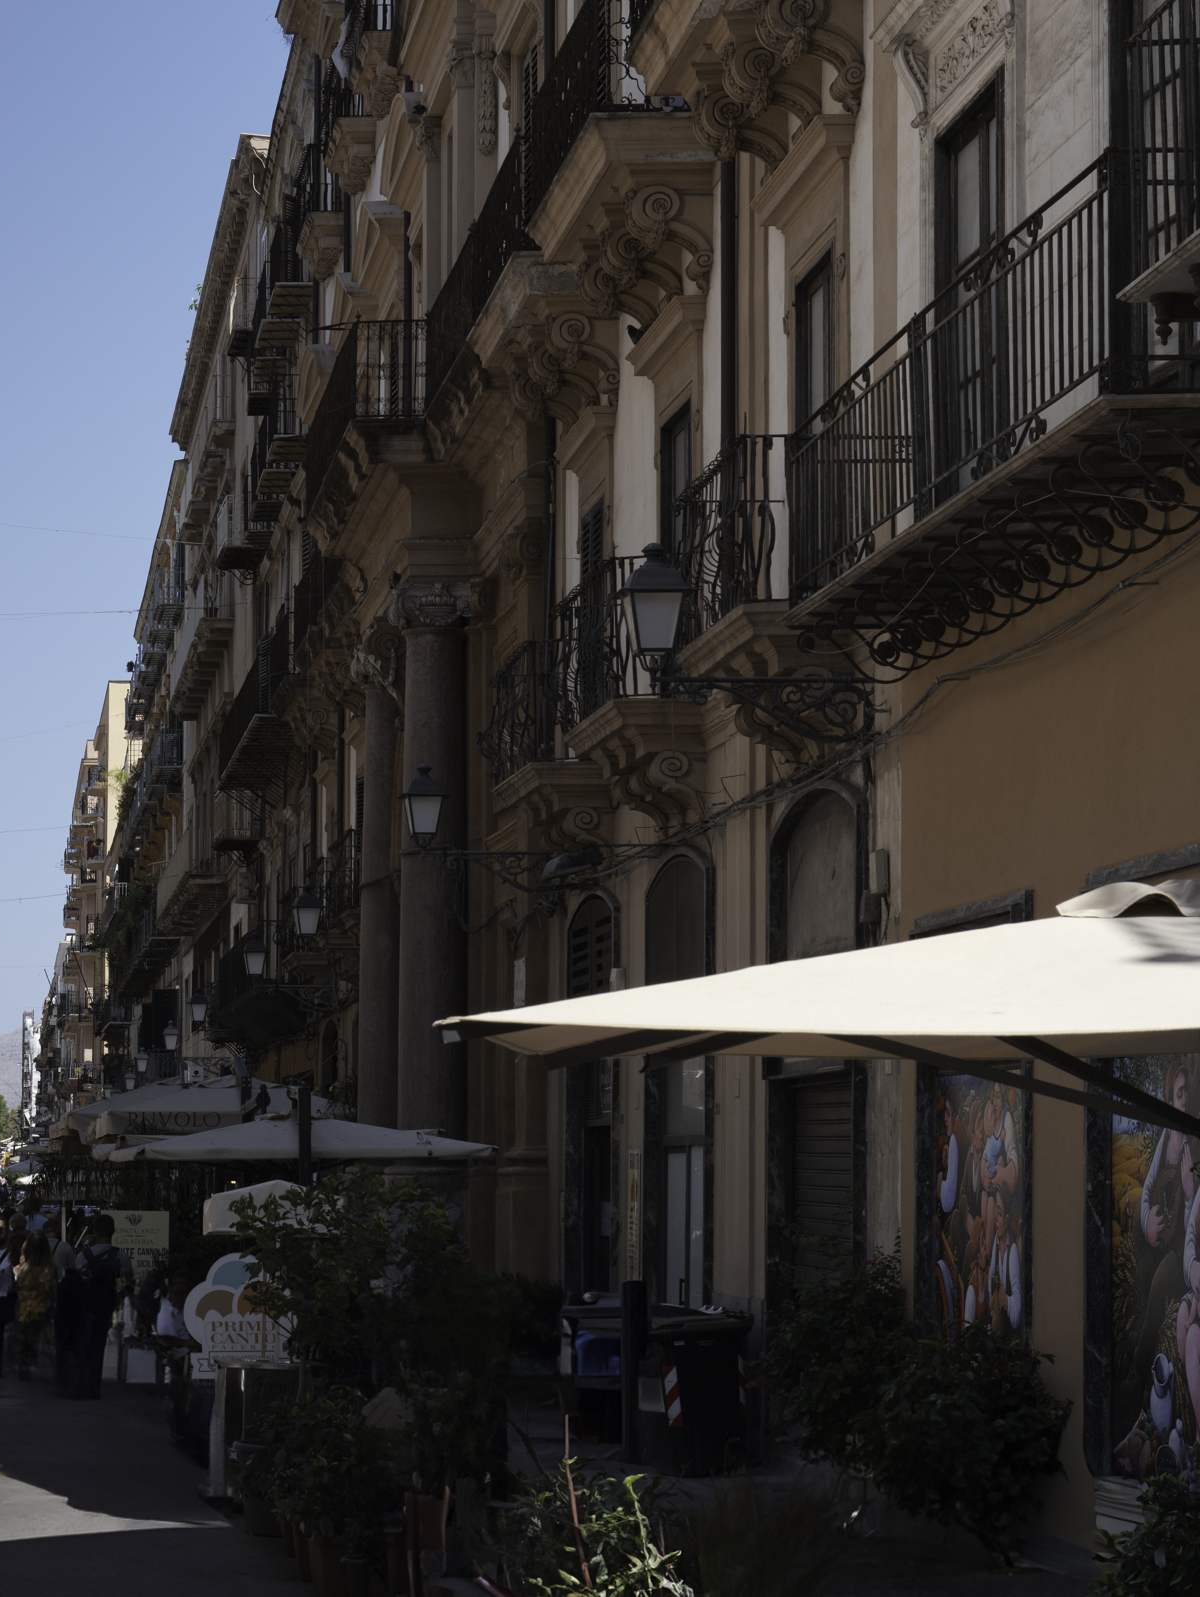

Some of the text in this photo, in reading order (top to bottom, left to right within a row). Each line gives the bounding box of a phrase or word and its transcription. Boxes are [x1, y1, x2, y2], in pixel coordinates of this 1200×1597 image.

[128, 1112, 220, 1129] RUVOLO
[134, 1227, 160, 1235] CANTO
[115, 1237, 154, 1245] GELATERIA
[211, 1321, 276, 1332] PRIMO
[210, 1333, 276, 1344] CANTO
